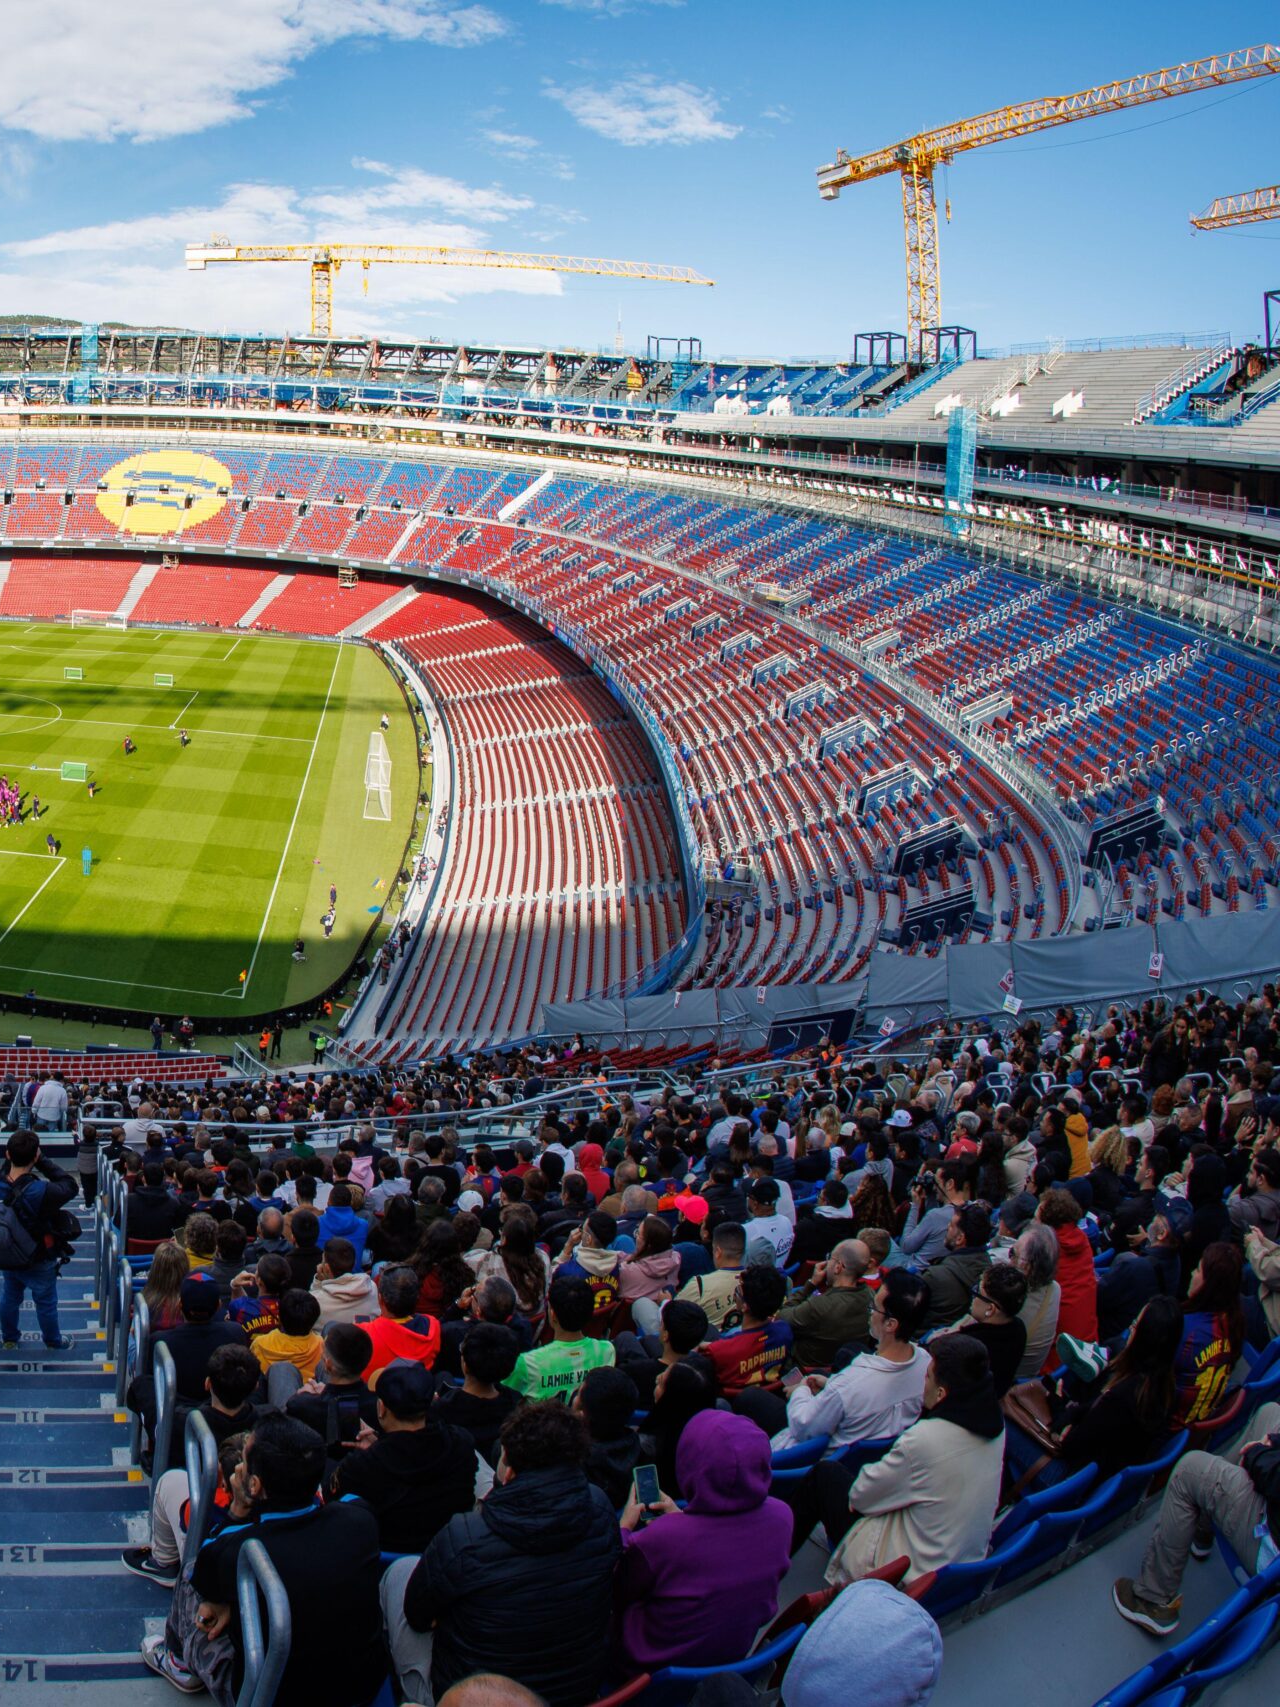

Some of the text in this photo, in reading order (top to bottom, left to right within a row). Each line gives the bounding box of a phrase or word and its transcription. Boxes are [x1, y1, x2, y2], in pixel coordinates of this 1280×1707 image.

[241, 1314, 273, 1333] LAMINE
[23, 1332, 41, 1341] 09
[740, 1344, 786, 1375] RAPHINHA
[1194, 1339, 1223, 1368] LAMINE
[22, 1362, 41, 1372] 10
[541, 1371, 574, 1388] LAMINE
[1185, 1364, 1231, 1424] 10
[22, 1411, 40, 1423] 11
[18, 1469, 41, 1484] 12
[10, 1545, 37, 1563] 13
[2, 1659, 38, 1682] 14
